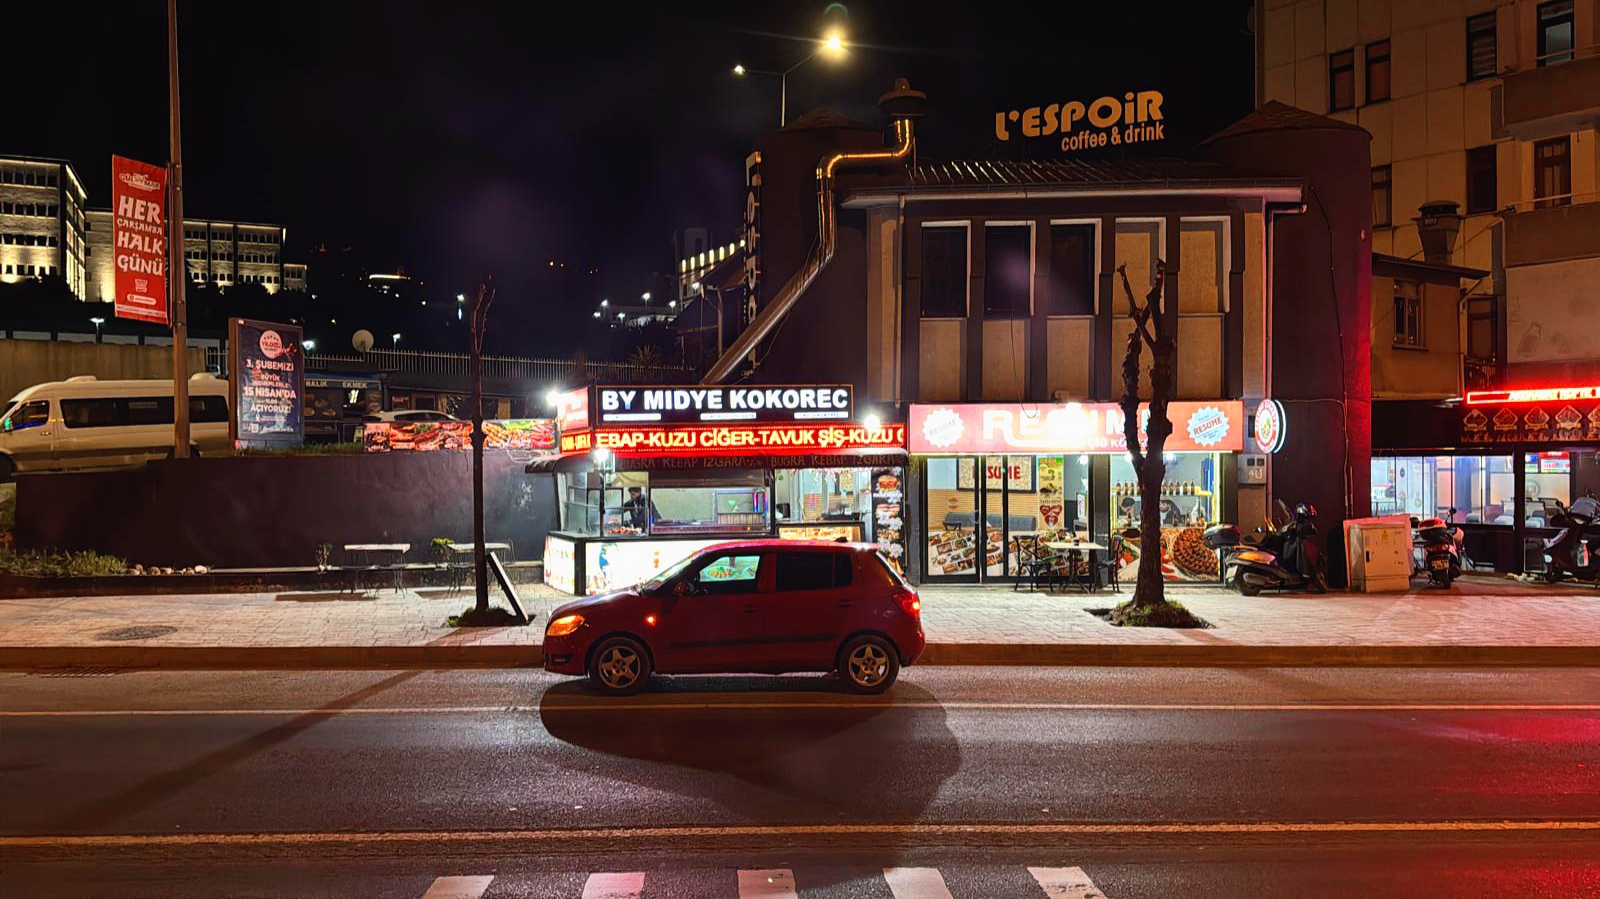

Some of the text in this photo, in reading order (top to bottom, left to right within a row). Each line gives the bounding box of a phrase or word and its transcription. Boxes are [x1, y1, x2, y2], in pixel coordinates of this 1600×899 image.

[1061, 121, 1165, 151] coffee & drink
[118, 195, 160, 225] HER
[117, 218, 162, 235] ÇARŞAMBA
[117, 231, 162, 255] HALK
[117, 253, 163, 276] GÜNÜ
[243, 386, 254, 396] 15
[602, 391, 636, 410] BY
[645, 390, 722, 410] MIDYE
[730, 389, 847, 409] KOKOREC
[1193, 416, 1223, 436] RESUME
